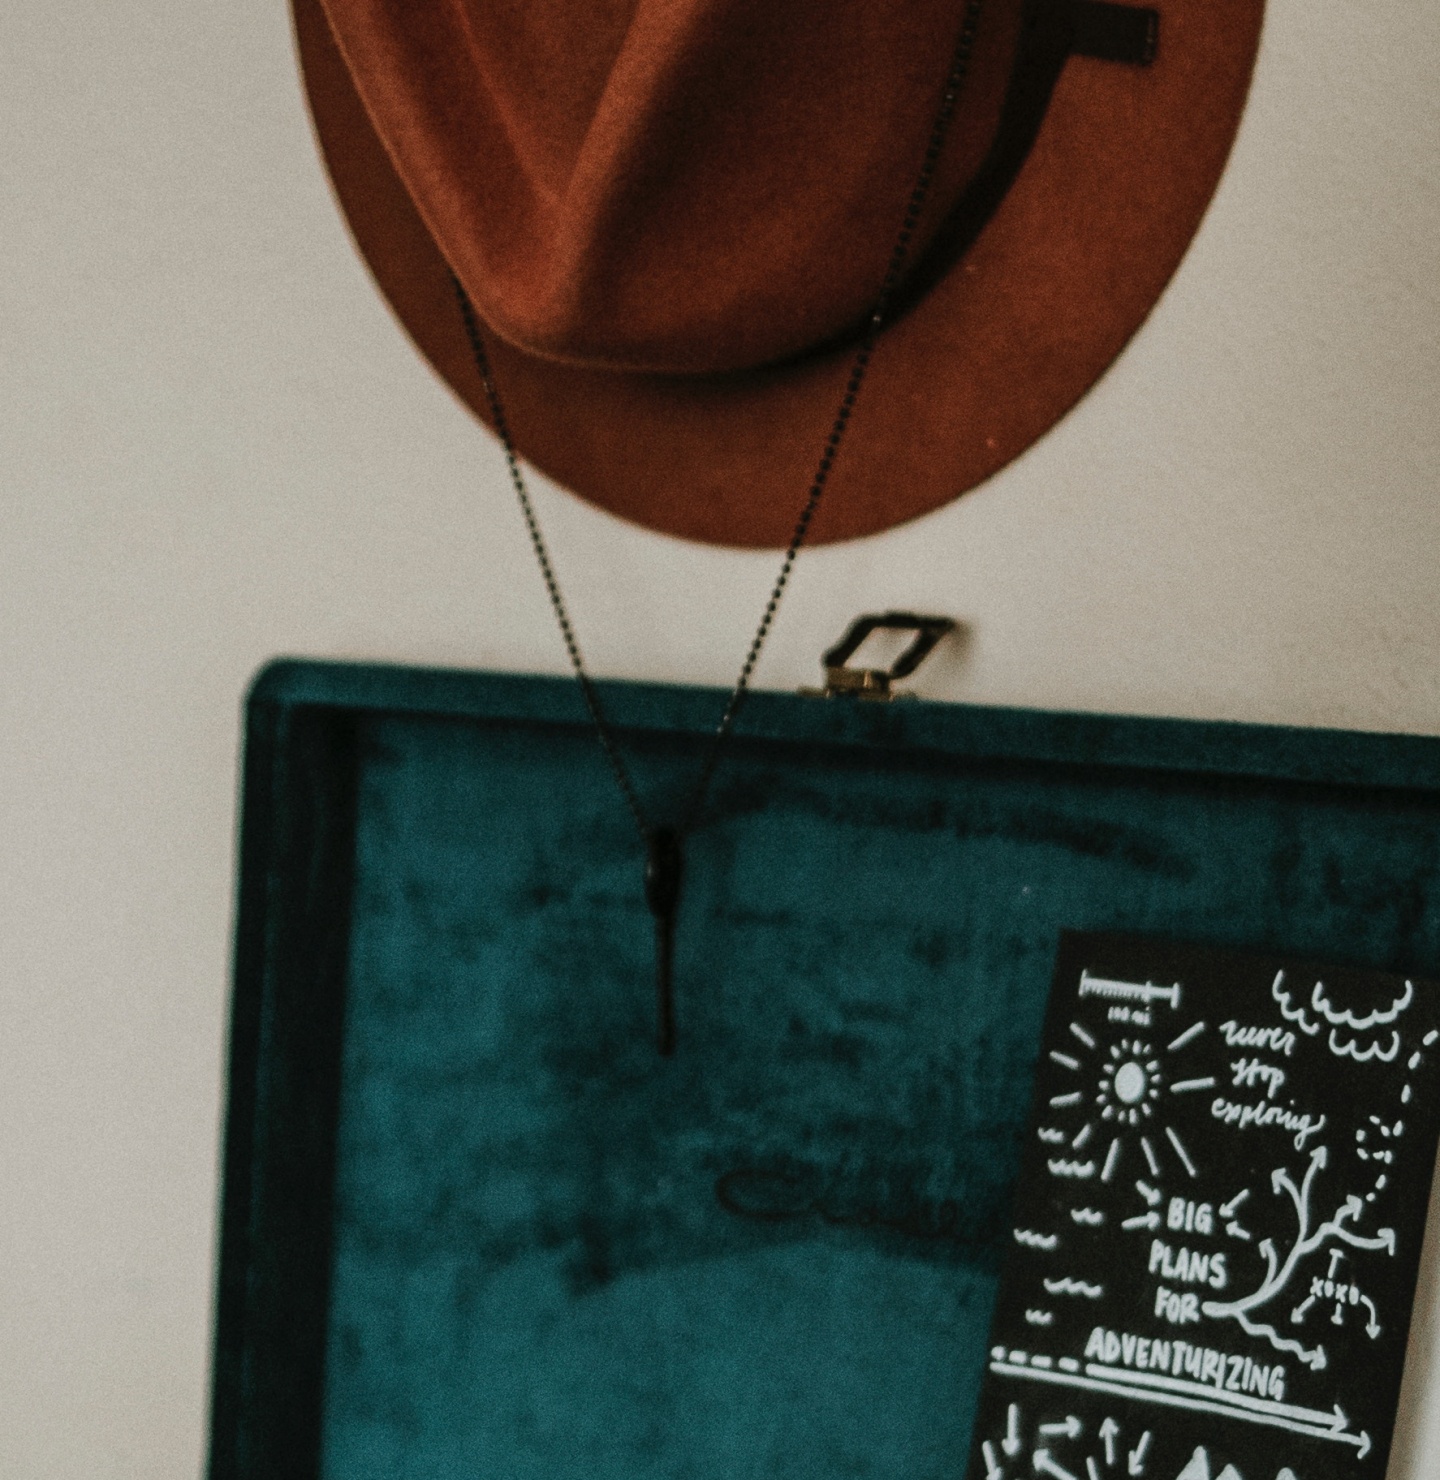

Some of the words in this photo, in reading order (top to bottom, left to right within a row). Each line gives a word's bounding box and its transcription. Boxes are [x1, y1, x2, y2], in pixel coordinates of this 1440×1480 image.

[1211, 1098, 1327, 1151] exploring
[1167, 1196, 1213, 1235] BIG
[1148, 1238, 1227, 1289] PLANS
[1154, 1285, 1200, 1325] FOR
[1084, 1326, 1286, 1401] ADVENTURIZING
